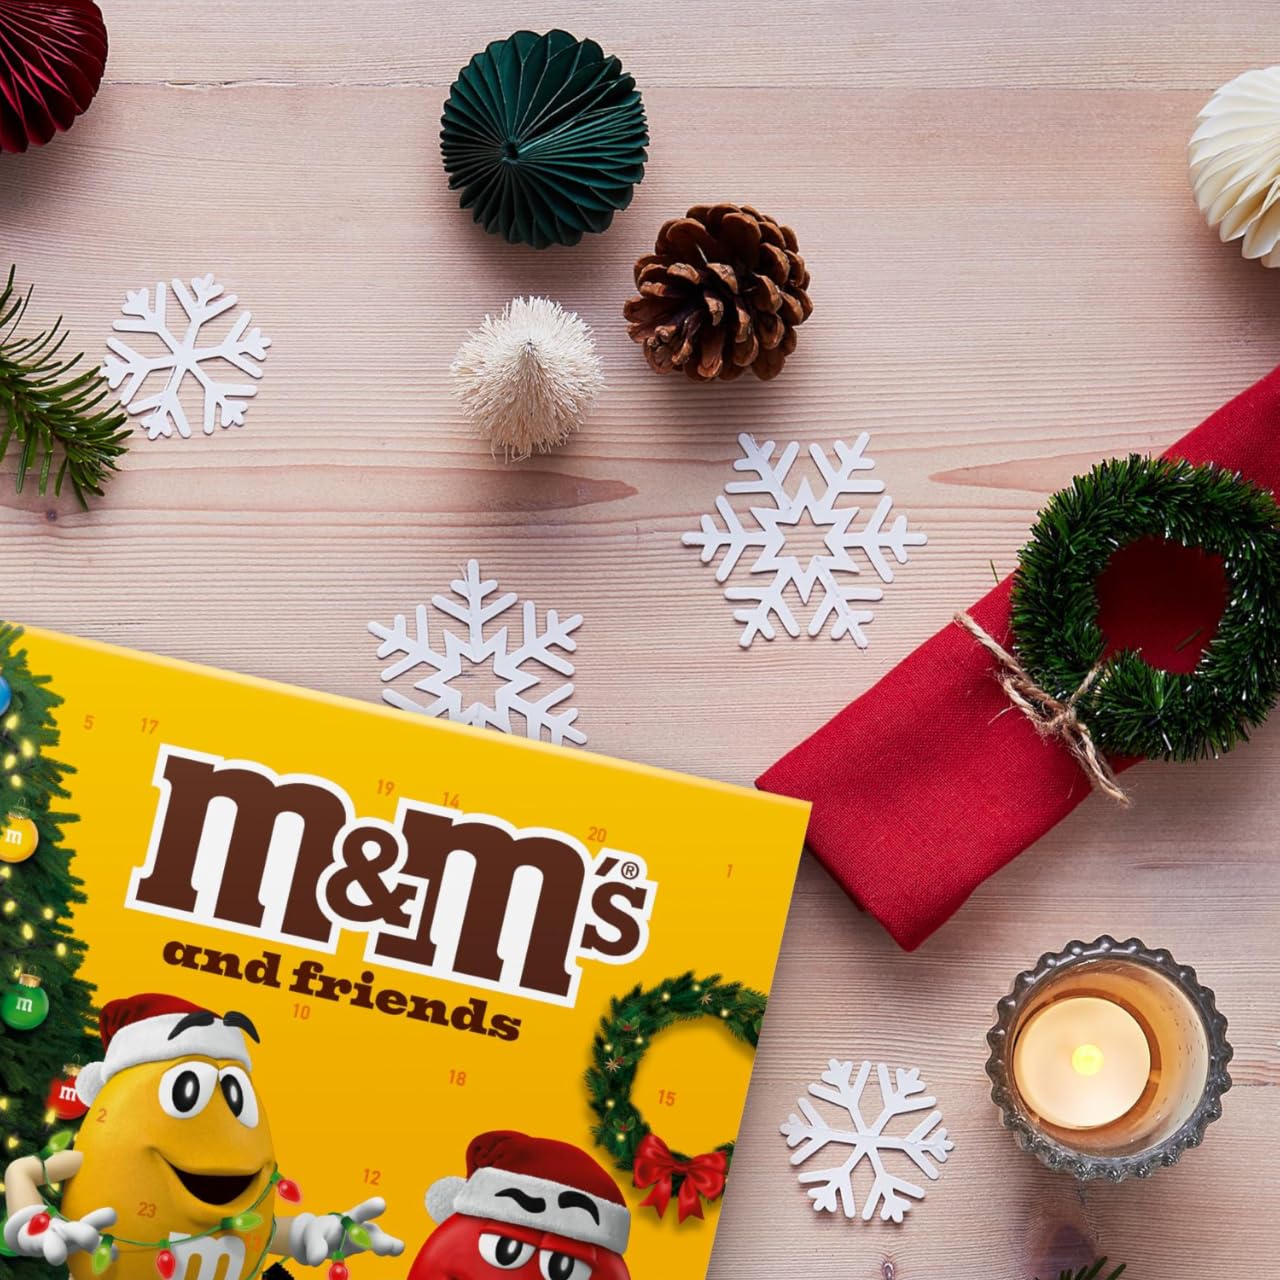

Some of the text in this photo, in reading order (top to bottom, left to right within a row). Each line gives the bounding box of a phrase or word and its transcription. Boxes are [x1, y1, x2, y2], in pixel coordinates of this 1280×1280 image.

[83, 714, 95, 731] 5
[140, 717, 160, 735] 17
[376, 778, 395, 796] 19
[441, 791, 460, 809] 14
[5, 829, 23, 846] m
[586, 825, 607, 843] 20
[725, 863, 733, 879] 1
[162, 940, 523, 1042] and friends
[15, 996, 33, 1013] m
[292, 1003, 311, 1021] 10
[448, 1069, 467, 1087] 18
[58, 1084, 78, 1102] m
[658, 1089, 676, 1107] 15
[96, 1108, 108, 1123] 2
[362, 1168, 381, 1186] 12
[137, 1201, 157, 1218] 23
